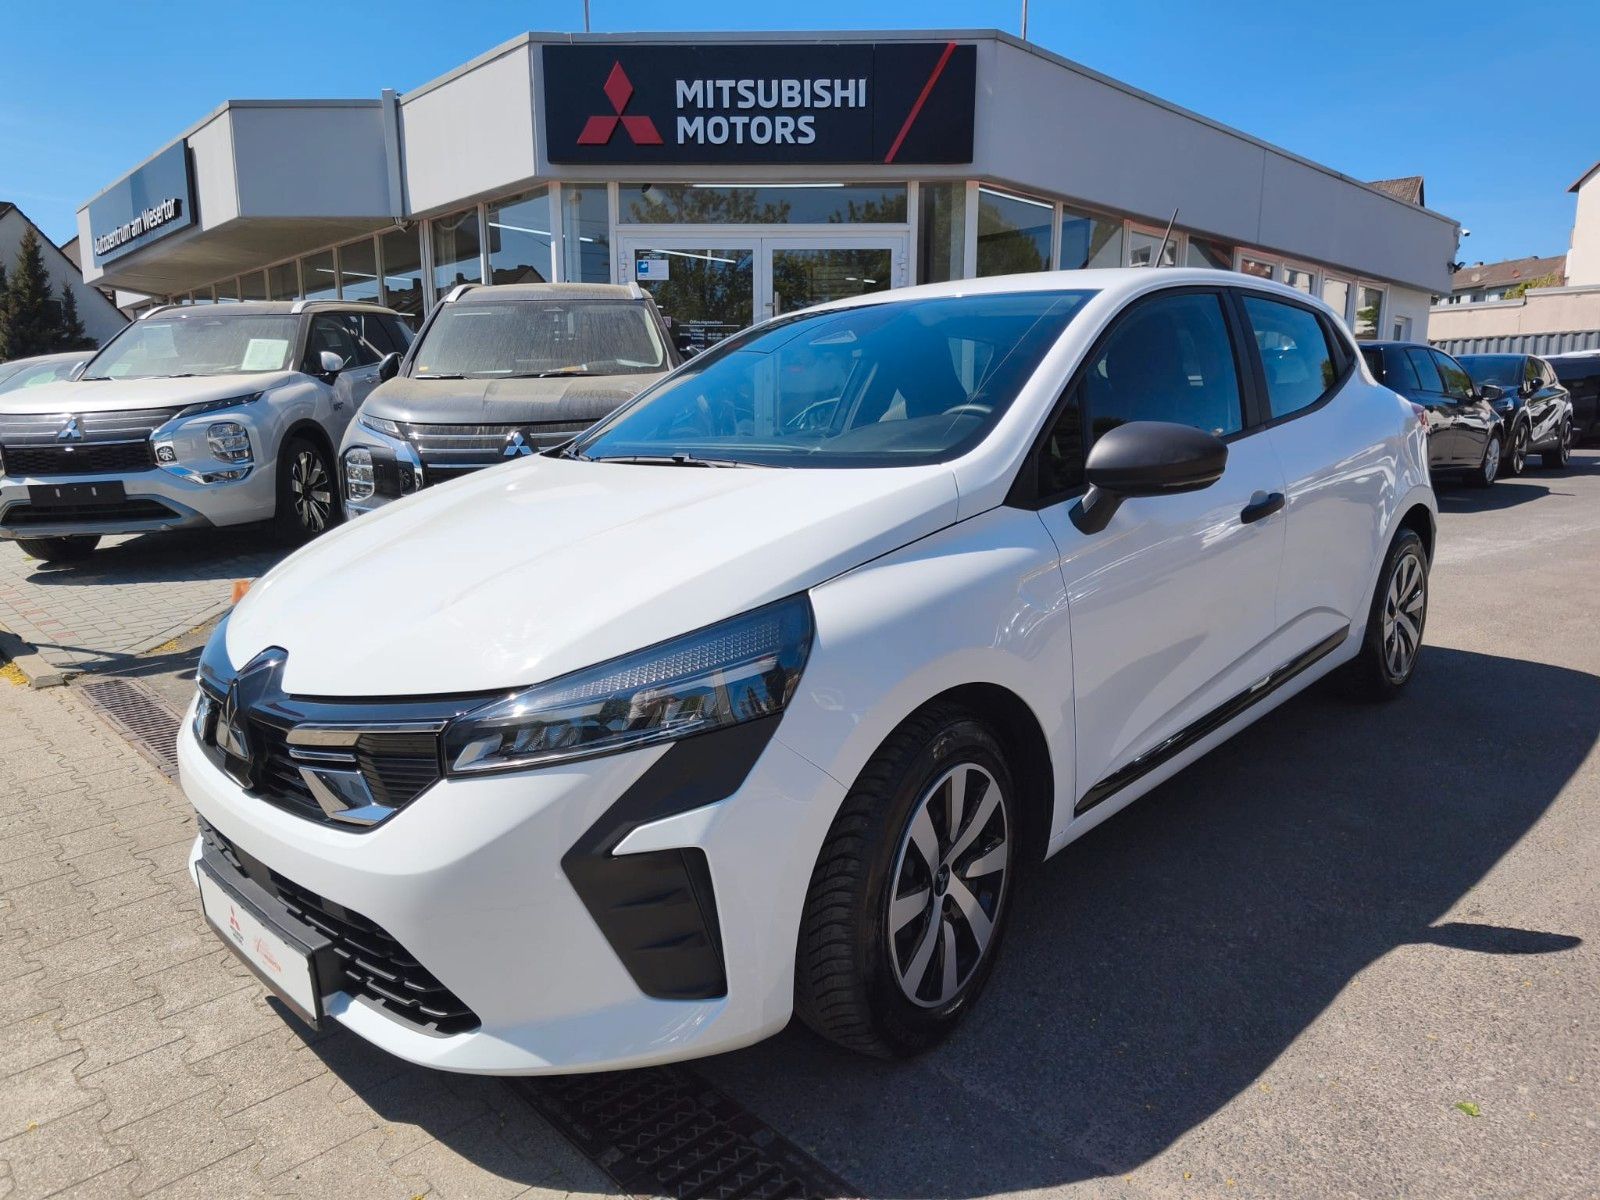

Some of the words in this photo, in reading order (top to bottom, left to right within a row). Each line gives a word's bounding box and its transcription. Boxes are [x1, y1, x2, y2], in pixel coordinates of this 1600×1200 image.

[675, 79, 867, 108] MITSUBISHI
[677, 116, 816, 144] MOTORS
[131, 217, 143, 236] am
[142, 198, 175, 231] Wesertor
